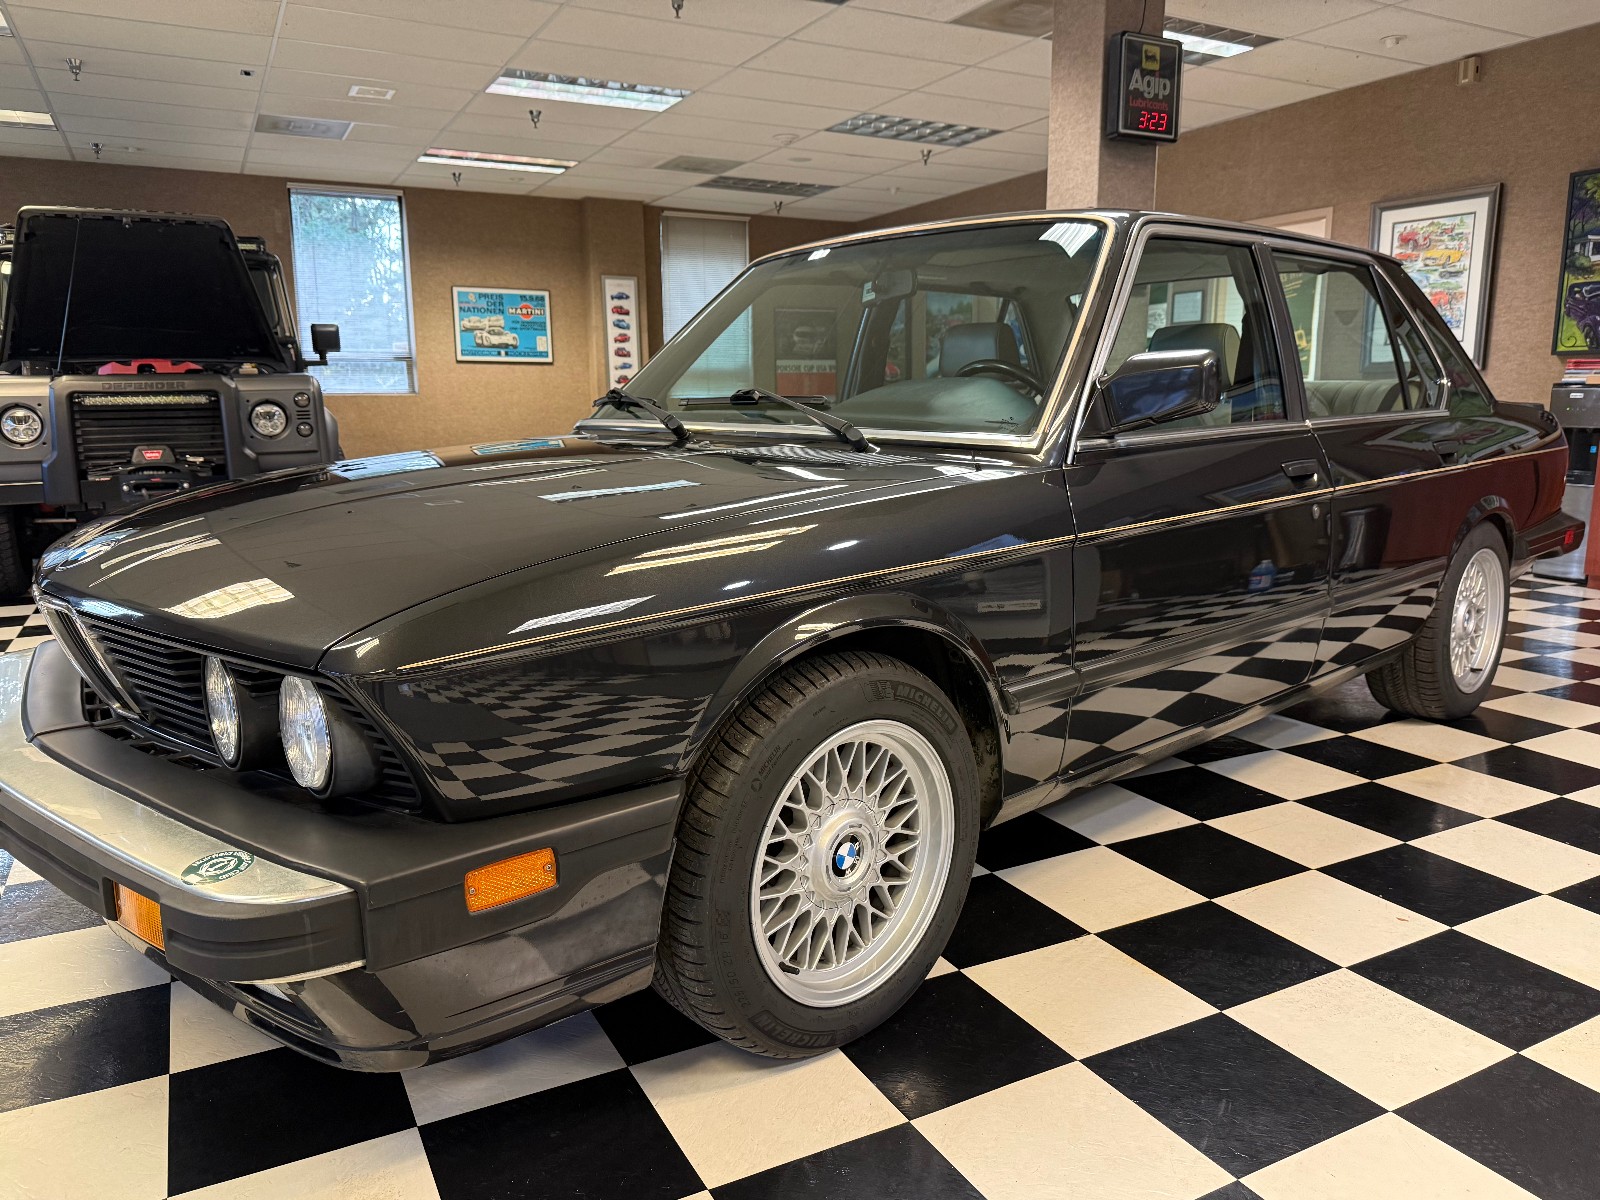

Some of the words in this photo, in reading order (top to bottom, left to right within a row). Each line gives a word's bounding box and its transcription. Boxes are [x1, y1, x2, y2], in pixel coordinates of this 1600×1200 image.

[1128, 68, 1171, 100] Agip
[1129, 96, 1169, 111] Lubricants
[1138, 110, 1168, 131] 3:23
[478, 292, 504, 301] PREIS
[486, 300, 504, 308] DER
[459, 306, 505, 315] NATIONEN
[508, 307, 545, 316] MARTINI
[101, 382, 186, 391] DEFENDER
[896, 684, 956, 731] MICHELIN
[752, 1013, 833, 1047] MICHELIN
